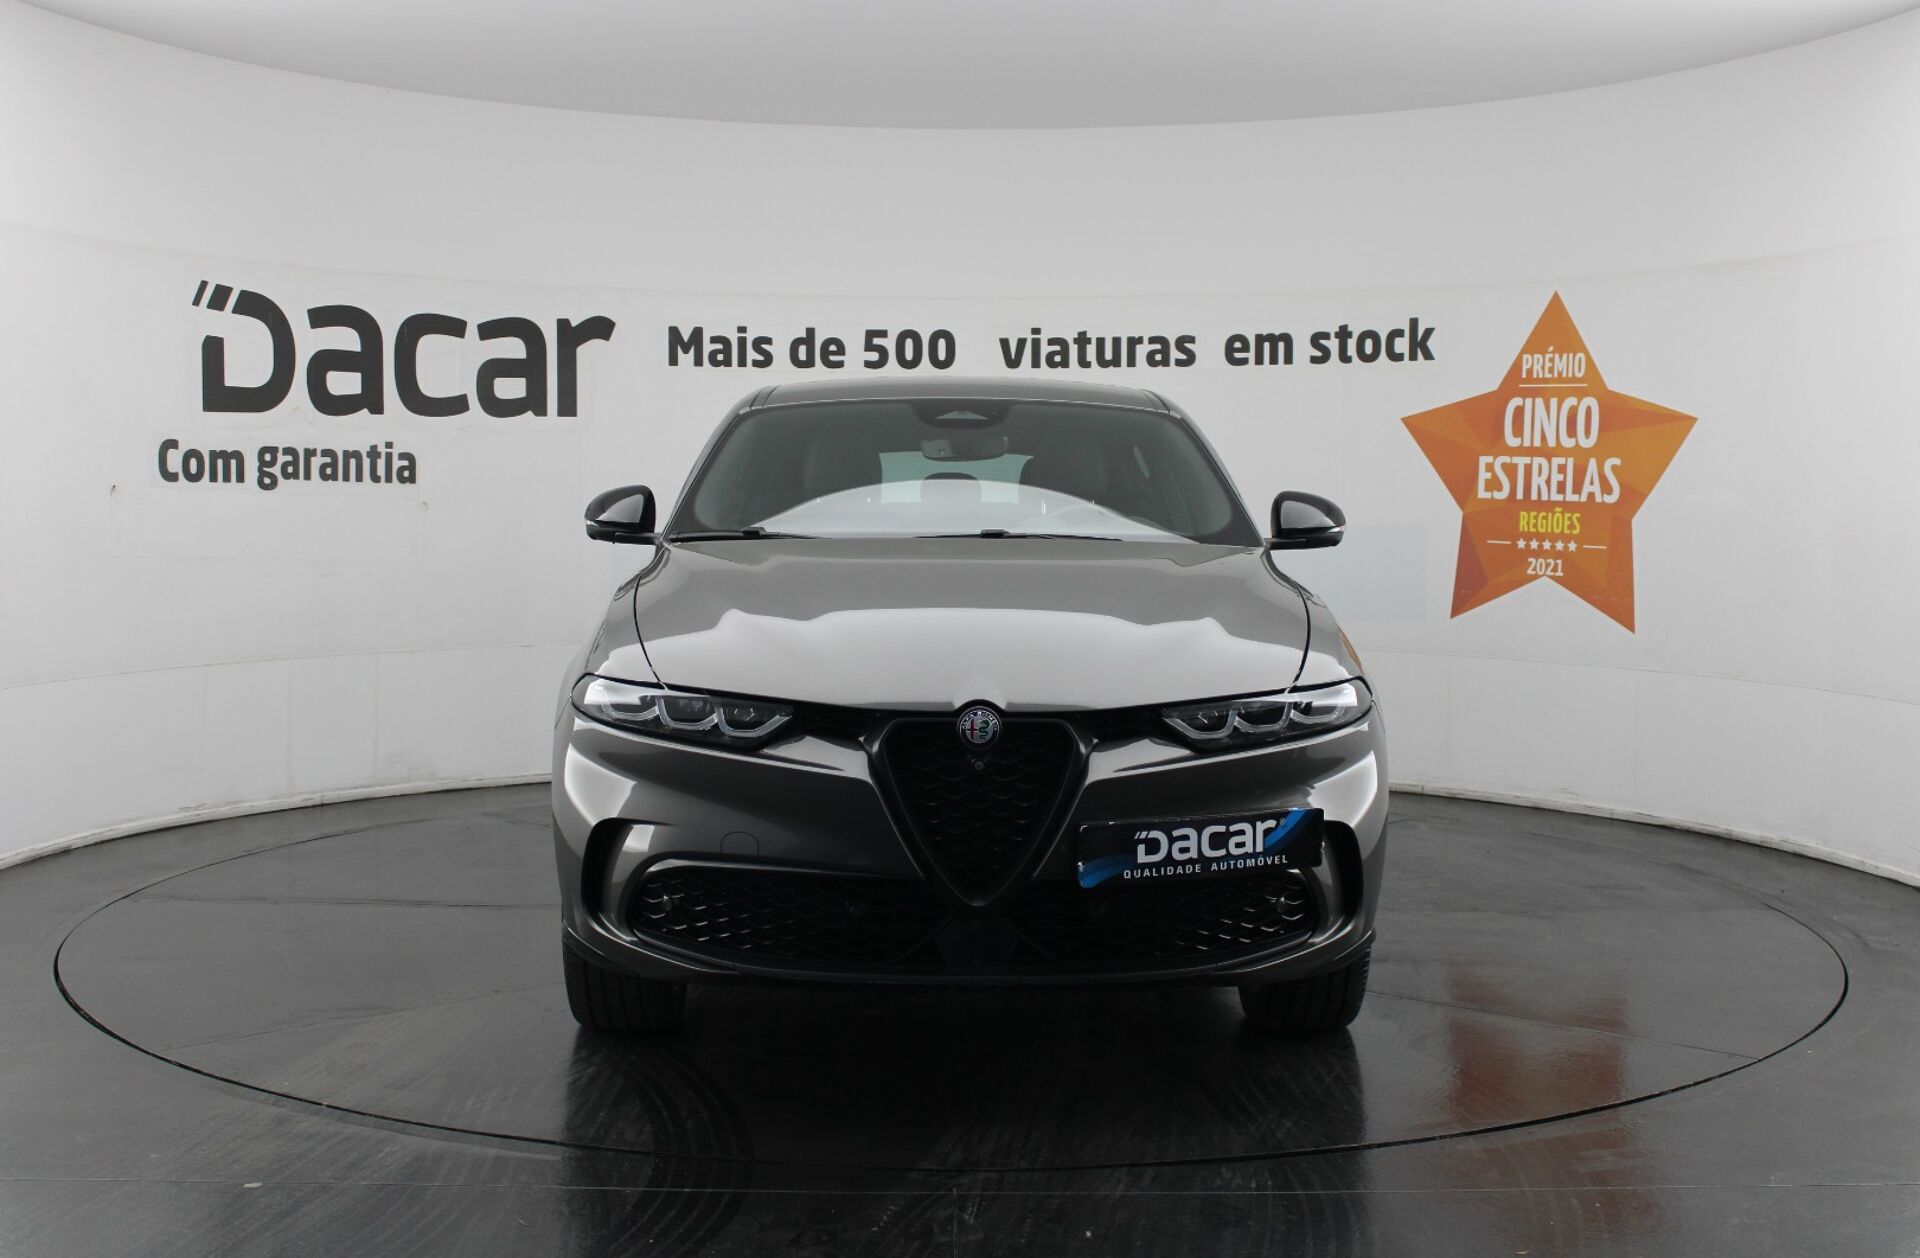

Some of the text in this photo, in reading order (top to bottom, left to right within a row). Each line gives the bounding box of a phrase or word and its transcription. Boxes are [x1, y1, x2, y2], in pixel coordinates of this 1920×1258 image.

[191, 279, 617, 418] Dacar
[668, 317, 1436, 370] Mais de 500 viaturas em stock
[1521, 346, 1587, 379] PRÉMIO
[1503, 396, 1600, 449] CINCO
[158, 438, 418, 491] Com garantia
[1476, 455, 1622, 504] ESTRELAS
[1519, 507, 1581, 535] REGIÕES
[1526, 557, 1564, 577] 2021
[1134, 818, 1277, 864] Dacar
[1123, 853, 1289, 879] QUALIDADE AUTOMÓVEL
